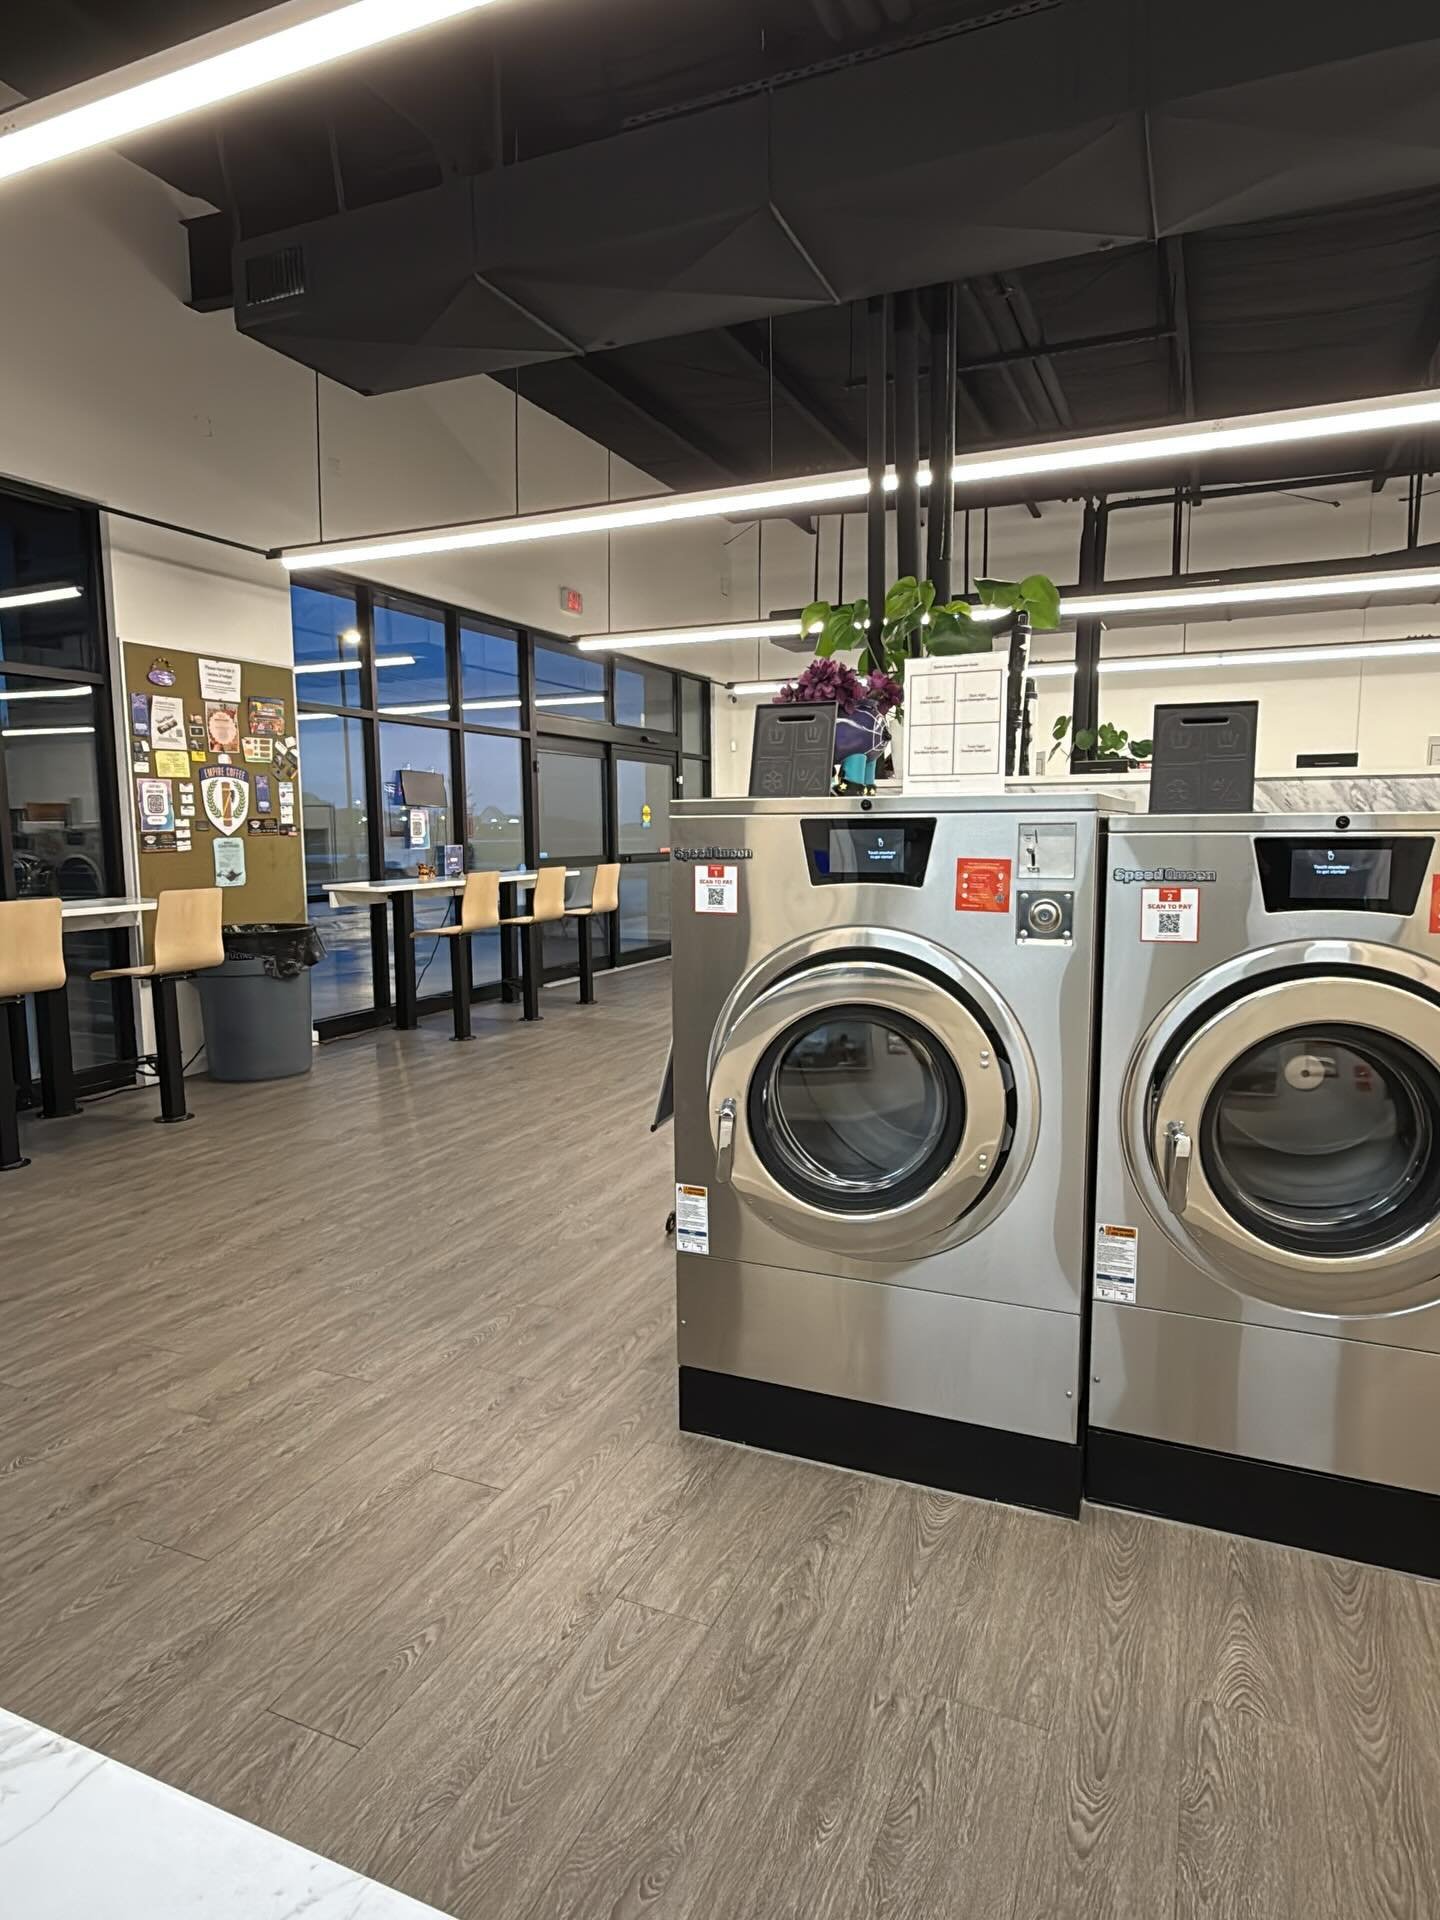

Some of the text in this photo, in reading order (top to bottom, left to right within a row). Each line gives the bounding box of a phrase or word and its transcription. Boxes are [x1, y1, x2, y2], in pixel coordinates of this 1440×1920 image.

[203, 767, 225, 779] EMPIRE
[226, 767, 246, 781] COFFEE
[1113, 868, 1216, 884] Speed Queen
